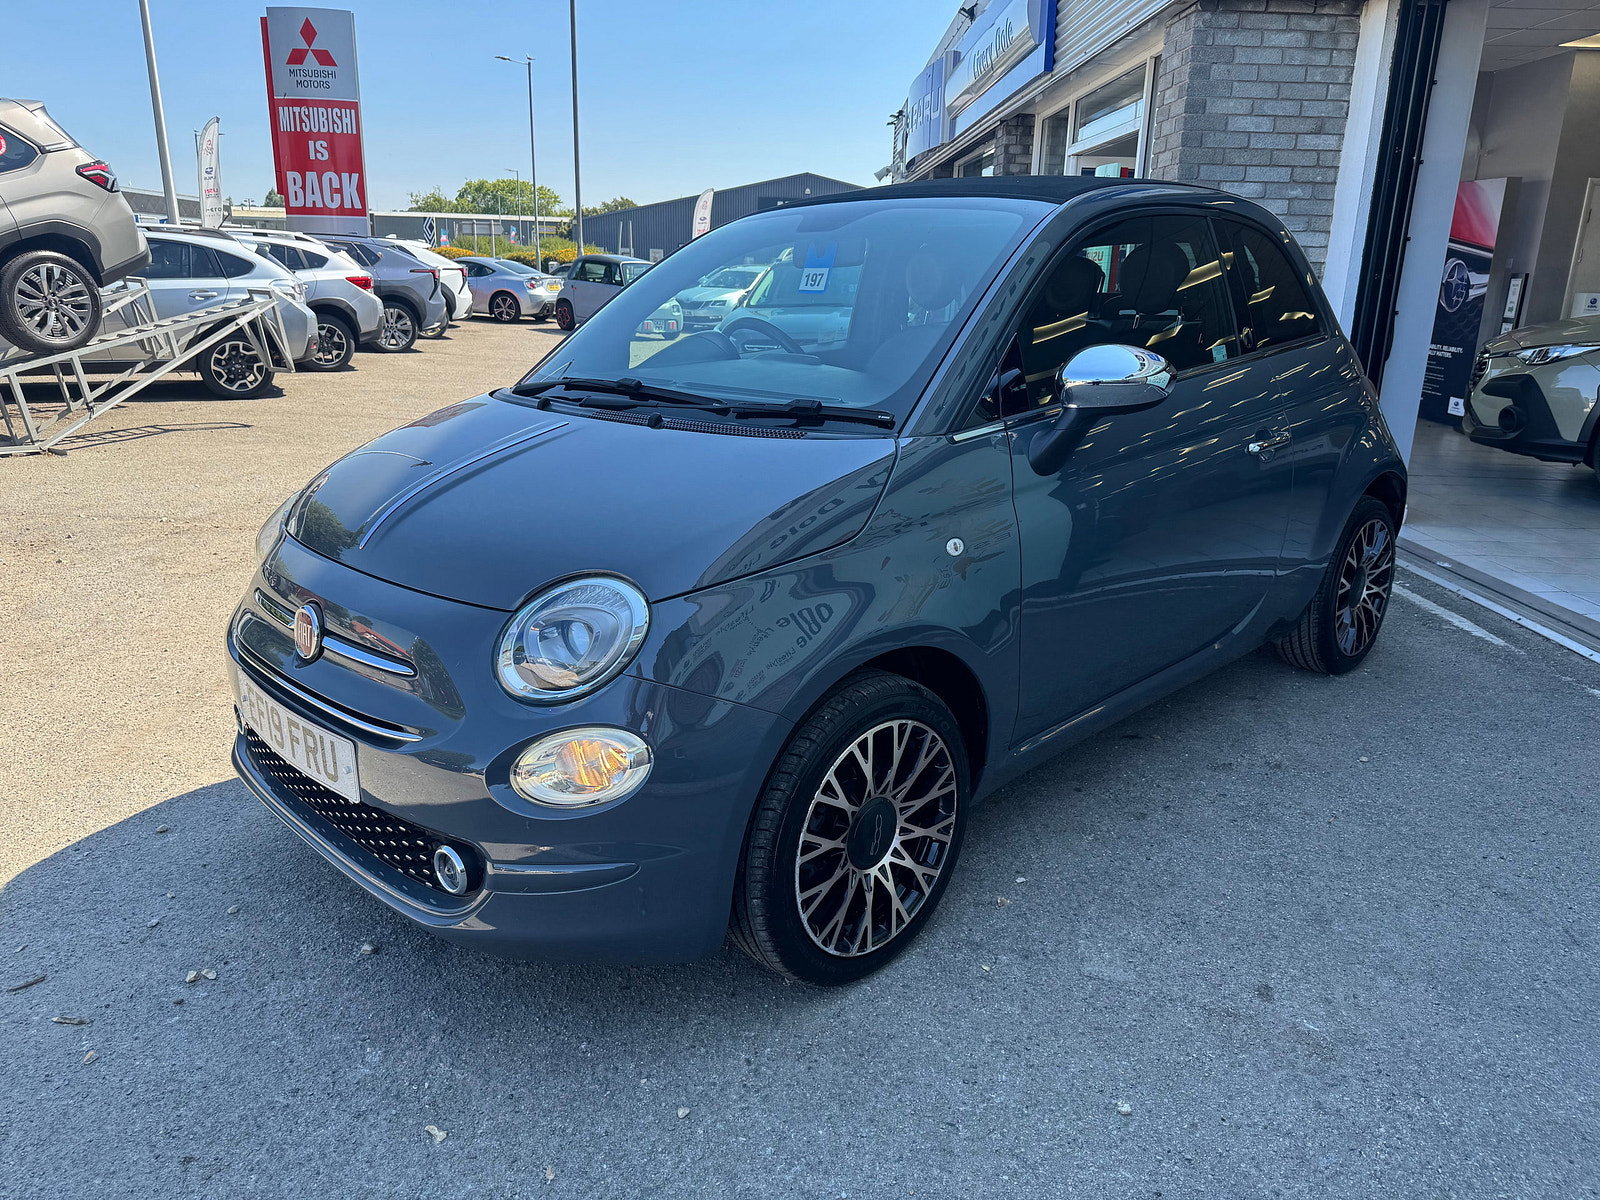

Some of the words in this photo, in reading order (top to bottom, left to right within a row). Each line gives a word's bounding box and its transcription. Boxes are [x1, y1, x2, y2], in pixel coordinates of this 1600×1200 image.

[288, 68, 337, 80] MITSUBISHI
[296, 79, 331, 90] MOTORS
[278, 106, 357, 135] MITSUBISHI
[308, 140, 329, 161] IS
[286, 171, 362, 209] BACK
[804, 272, 825, 287] 197
[286, 716, 339, 783] FRU
